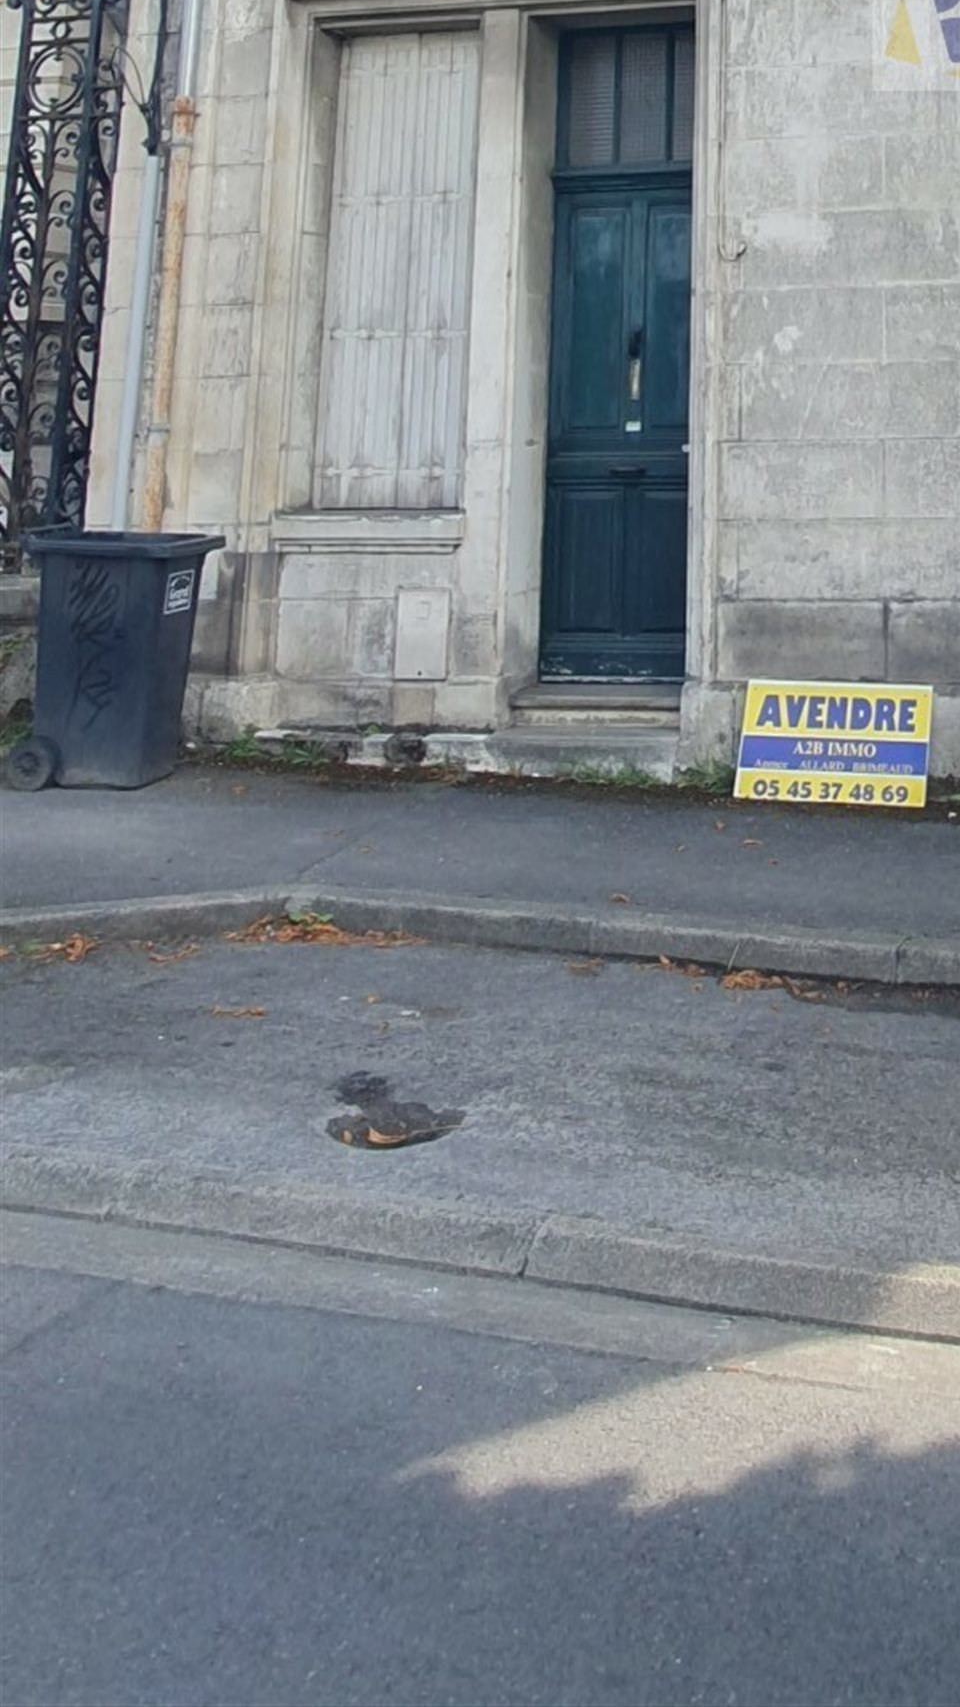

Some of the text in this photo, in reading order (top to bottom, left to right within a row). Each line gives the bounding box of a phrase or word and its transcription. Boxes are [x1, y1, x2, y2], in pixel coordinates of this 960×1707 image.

[793, 741, 877, 758] A2B IMMO
[753, 779, 908, 803] 05 45 37 48 69
